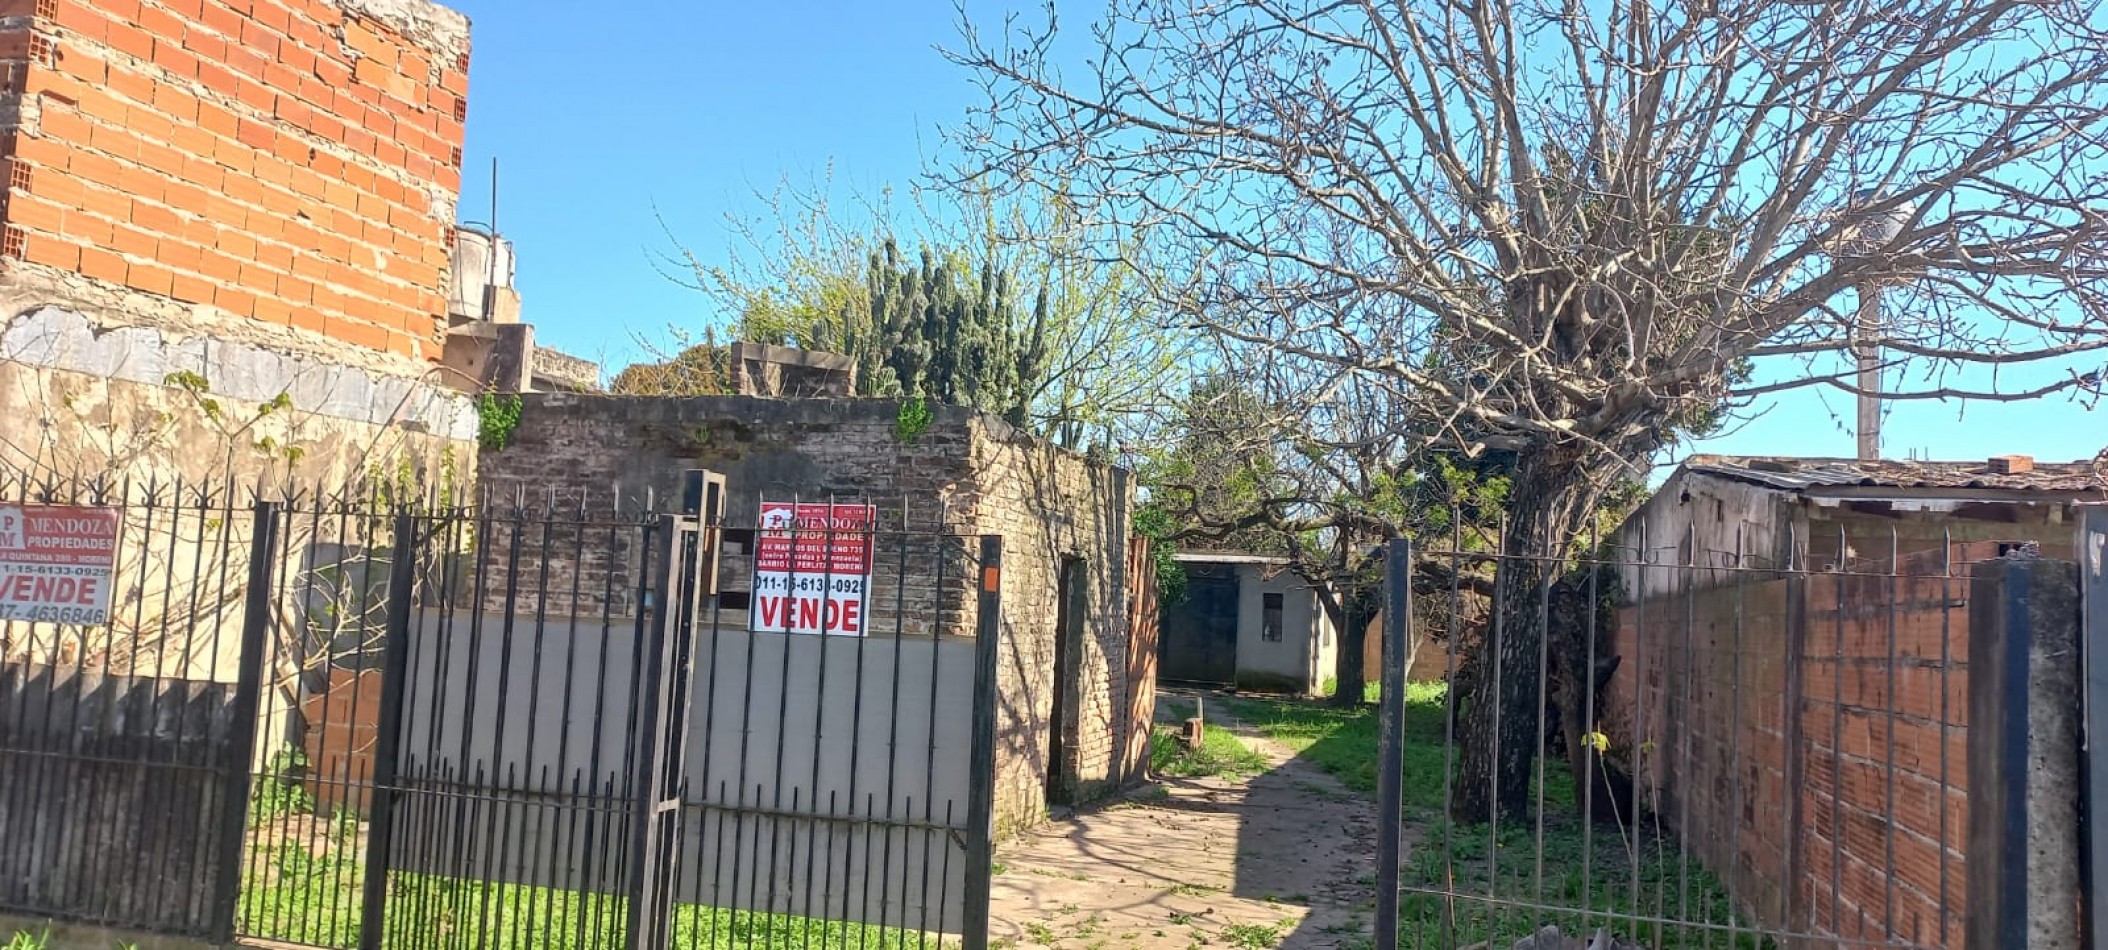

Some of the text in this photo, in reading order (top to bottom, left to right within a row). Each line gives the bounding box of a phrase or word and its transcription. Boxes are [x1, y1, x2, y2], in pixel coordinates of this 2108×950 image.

[29, 517, 114, 536] MENDOZA
[27, 536, 114, 550] PROPIEDADES
[26, 605, 105, 624] 4636846
[759, 595, 861, 632] VENDE
